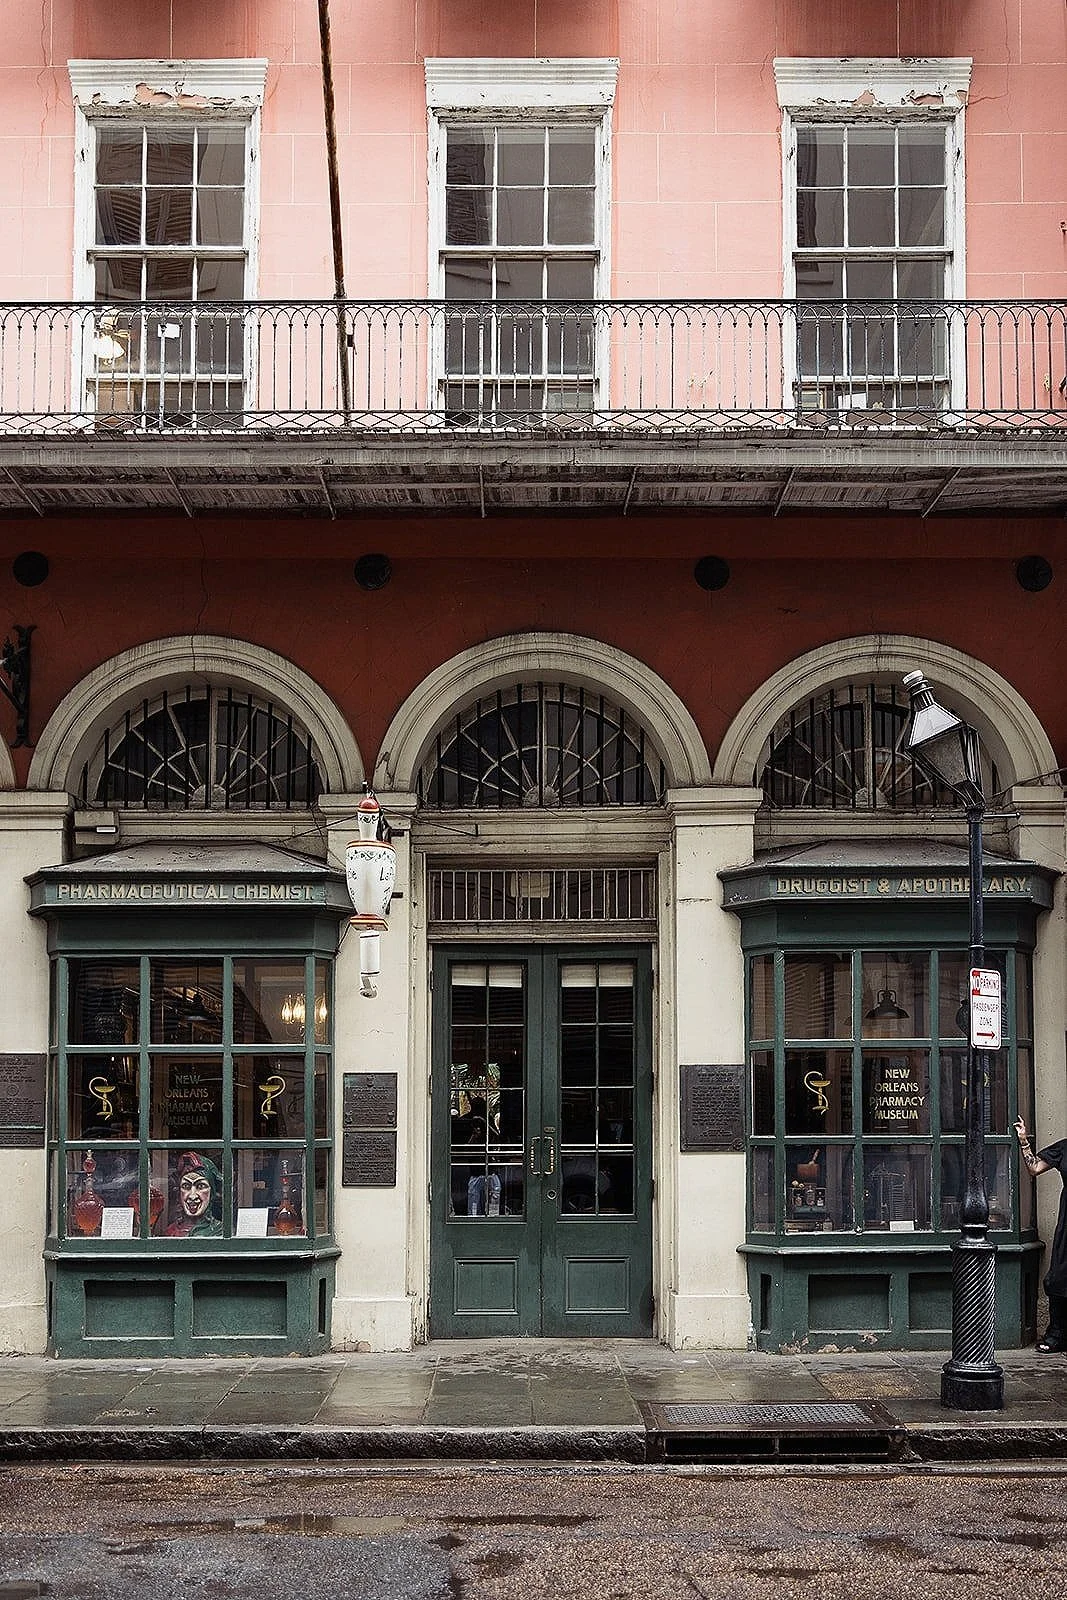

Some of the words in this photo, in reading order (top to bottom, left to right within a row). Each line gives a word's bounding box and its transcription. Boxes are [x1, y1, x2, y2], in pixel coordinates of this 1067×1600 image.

[776, 878, 871, 893] DRUGGIST
[877, 878, 890, 893] &
[896, 877, 1031, 893] APOTHEARY.
[57, 884, 229, 899] PHARMACEUTICAL
[885, 1069, 911, 1079] NEW
[175, 1074, 200, 1085] NEW
[874, 1082, 919, 1092] ORLEANS
[165, 1088, 209, 1098] ORLEANS
[870, 1096, 926, 1107] PHARMACY
[160, 1102, 215, 1112] PHARMACY
[874, 1109, 919, 1120] MUSEUM
[166, 1115, 208, 1125] MUSEUM
